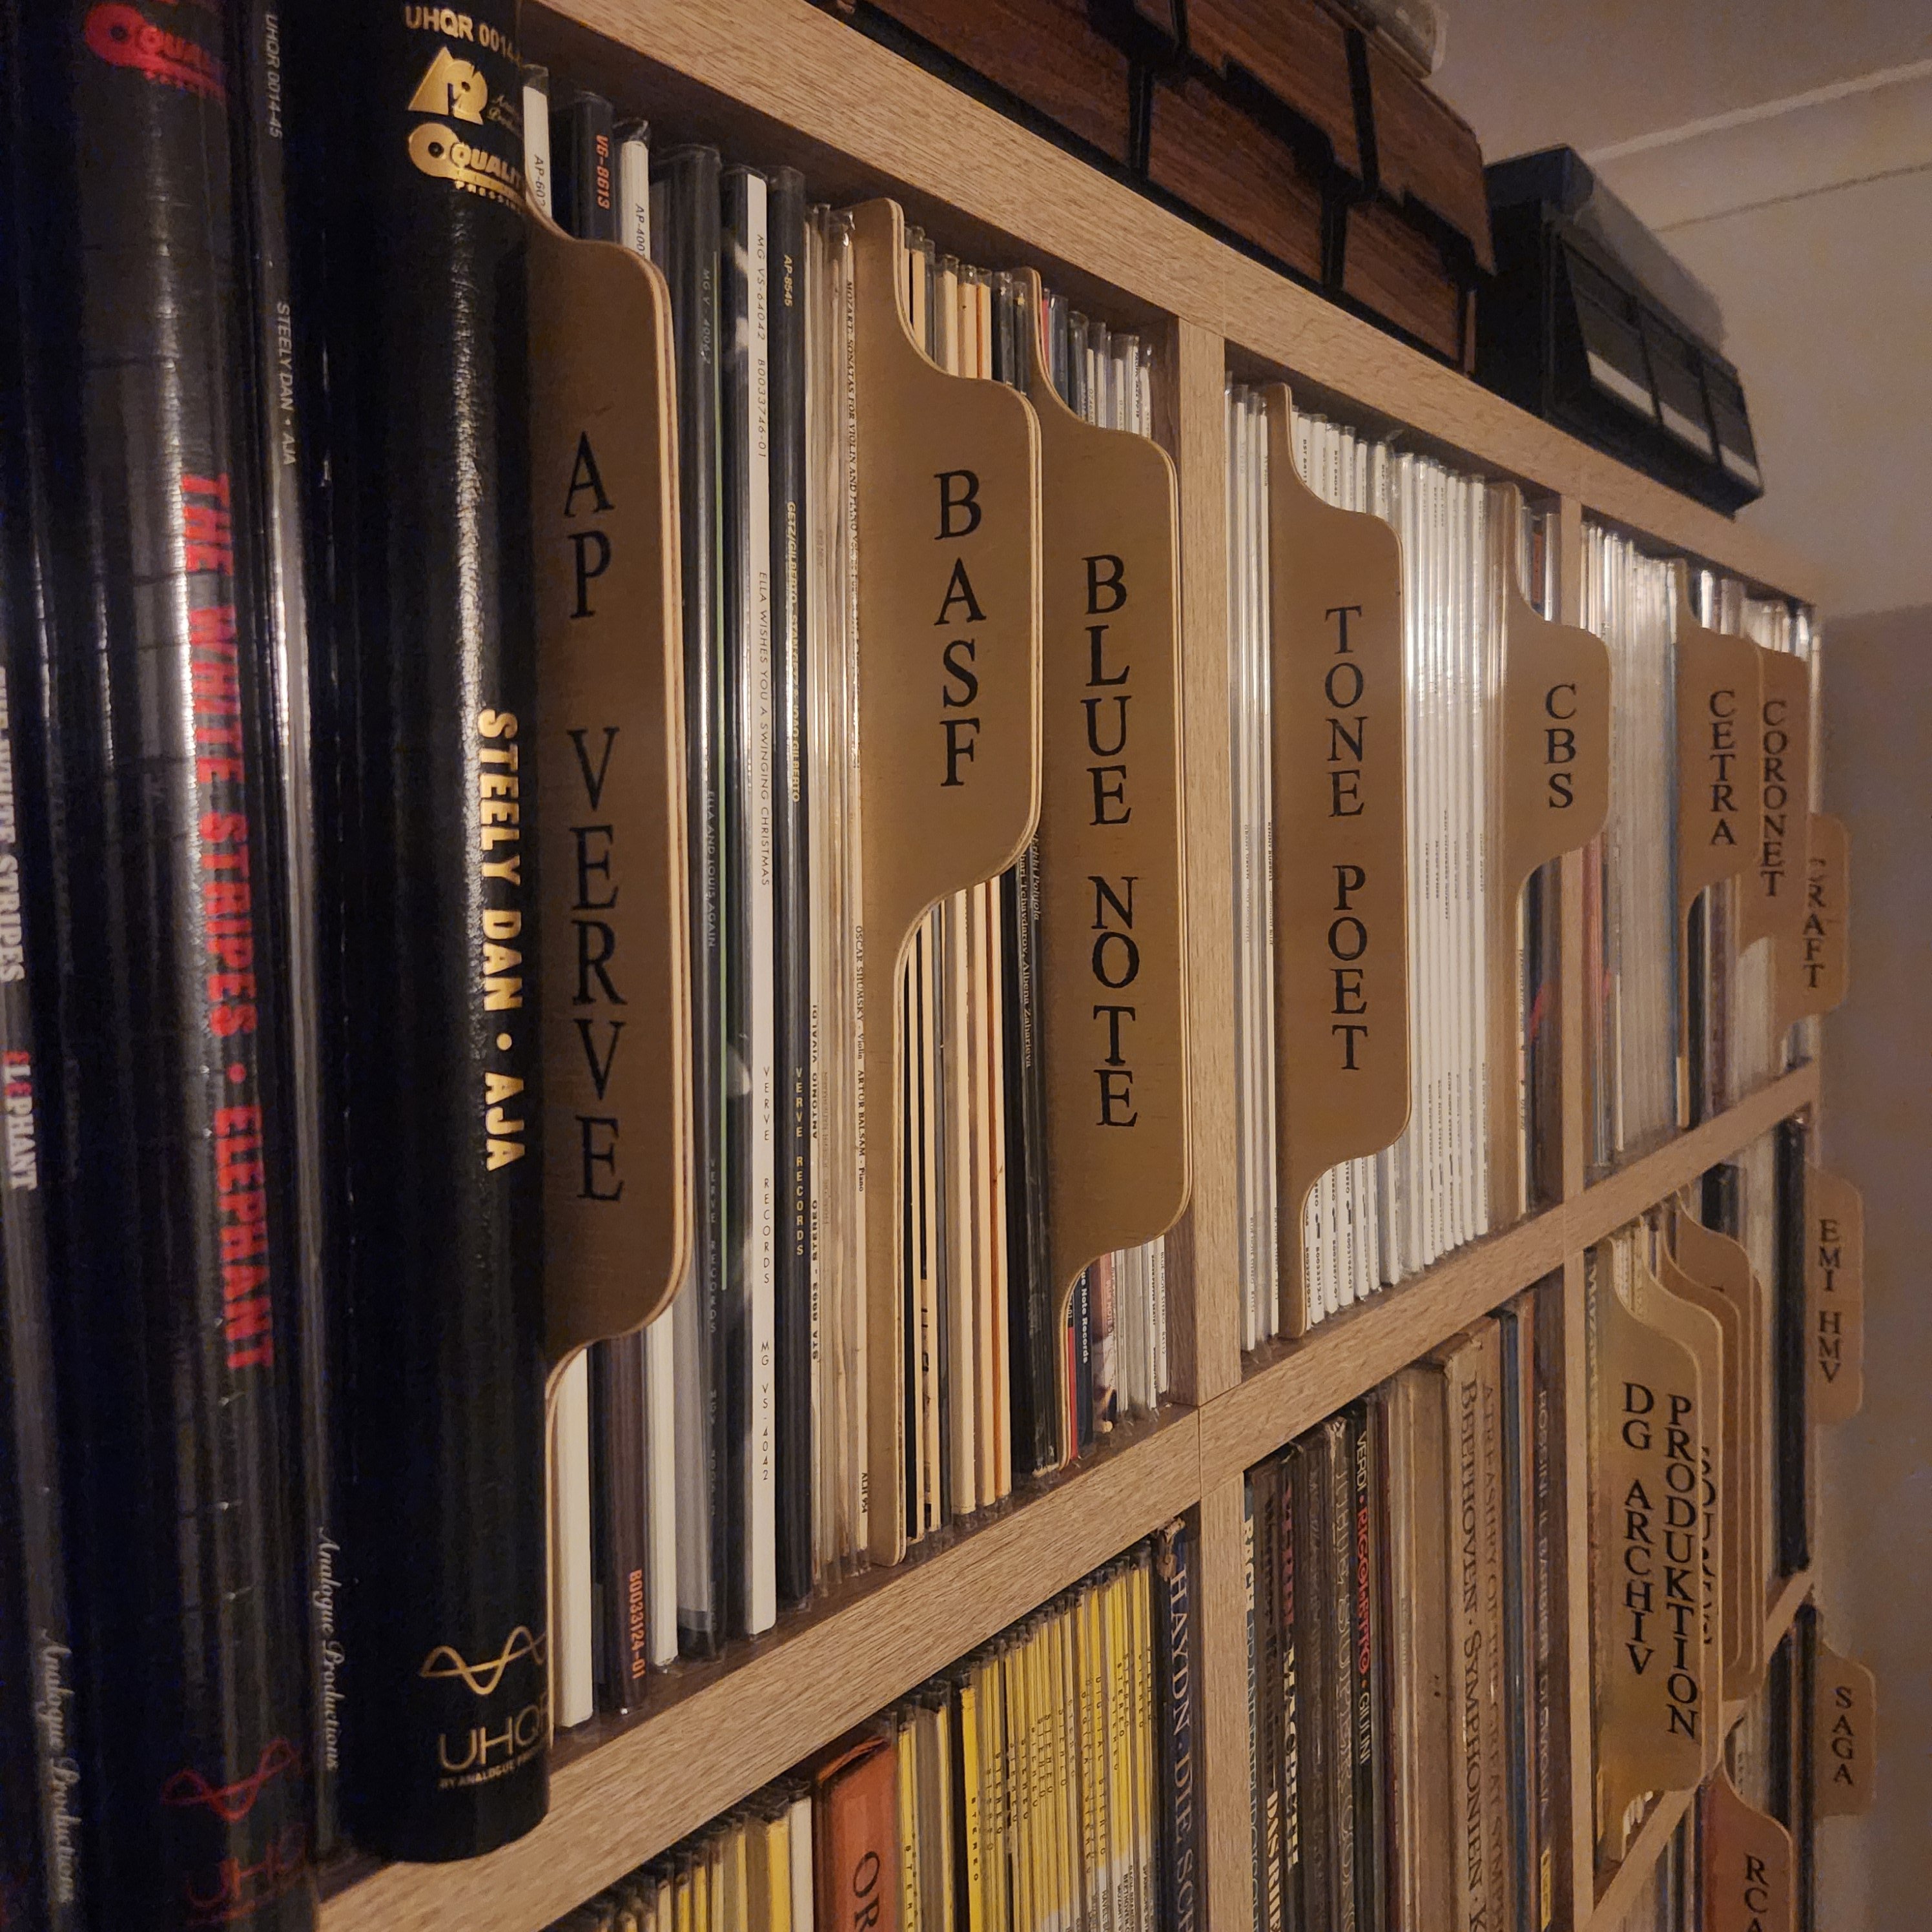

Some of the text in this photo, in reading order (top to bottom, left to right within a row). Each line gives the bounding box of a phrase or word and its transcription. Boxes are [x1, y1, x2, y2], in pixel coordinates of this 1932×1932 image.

[405, 6, 474, 42] UHQR
[757, 234, 765, 262] MG
[277, 300, 298, 466] STEELY DAN AJA
[760, 610, 768, 664] WISHES
[761, 708, 767, 717] A
[933, 469, 987, 787] BASF
[563, 430, 628, 1202] AP VERVE
[760, 723, 769, 800] SWINGING
[1544, 684, 1577, 810] CBS
[1709, 689, 1739, 847] CETRA
[1760, 700, 1789, 898] CORONET
[180, 473, 274, 1370] THE WHITE STRIPES ELEPHANT
[761, 807, 770, 886] CHRISTMAS
[1080, 553, 1140, 1127] BLUE NOTE
[1324, 605, 1368, 1071] TONE POET
[0, 854, 39, 1191] STRIPES ELEPHANT
[477, 708, 526, 1172] STEELY DAN AJA
[795, 1067, 805, 1255] VERVE RECORDS
[858, 1069, 866, 1109] ARTUR
[858, 1111, 866, 1157] BALSAM
[761, 1341, 770, 1366] MG
[1817, 1217, 1842, 1384] EMI HMV
[1356, 1430, 1368, 1492] VERDI
[1461, 1370, 1479, 1614] BEETHOVEN
[1621, 1381, 1654, 1676] DG ARCHIV
[313, 1526, 345, 1773] Analogue Productions
[1169, 1561, 1191, 1737] HAYDN
[1356, 1506, 1372, 1676] RIGOLETTO
[1663, 1393, 1699, 1740] PRODUKTION
[36, 1627, 82, 1904] Analogue Productions
[1463, 1629, 1483, 1892] SYMPHONIEN
[1831, 1686, 1855, 1787] SAGA
[1266, 1789, 1279, 1858] DAS
